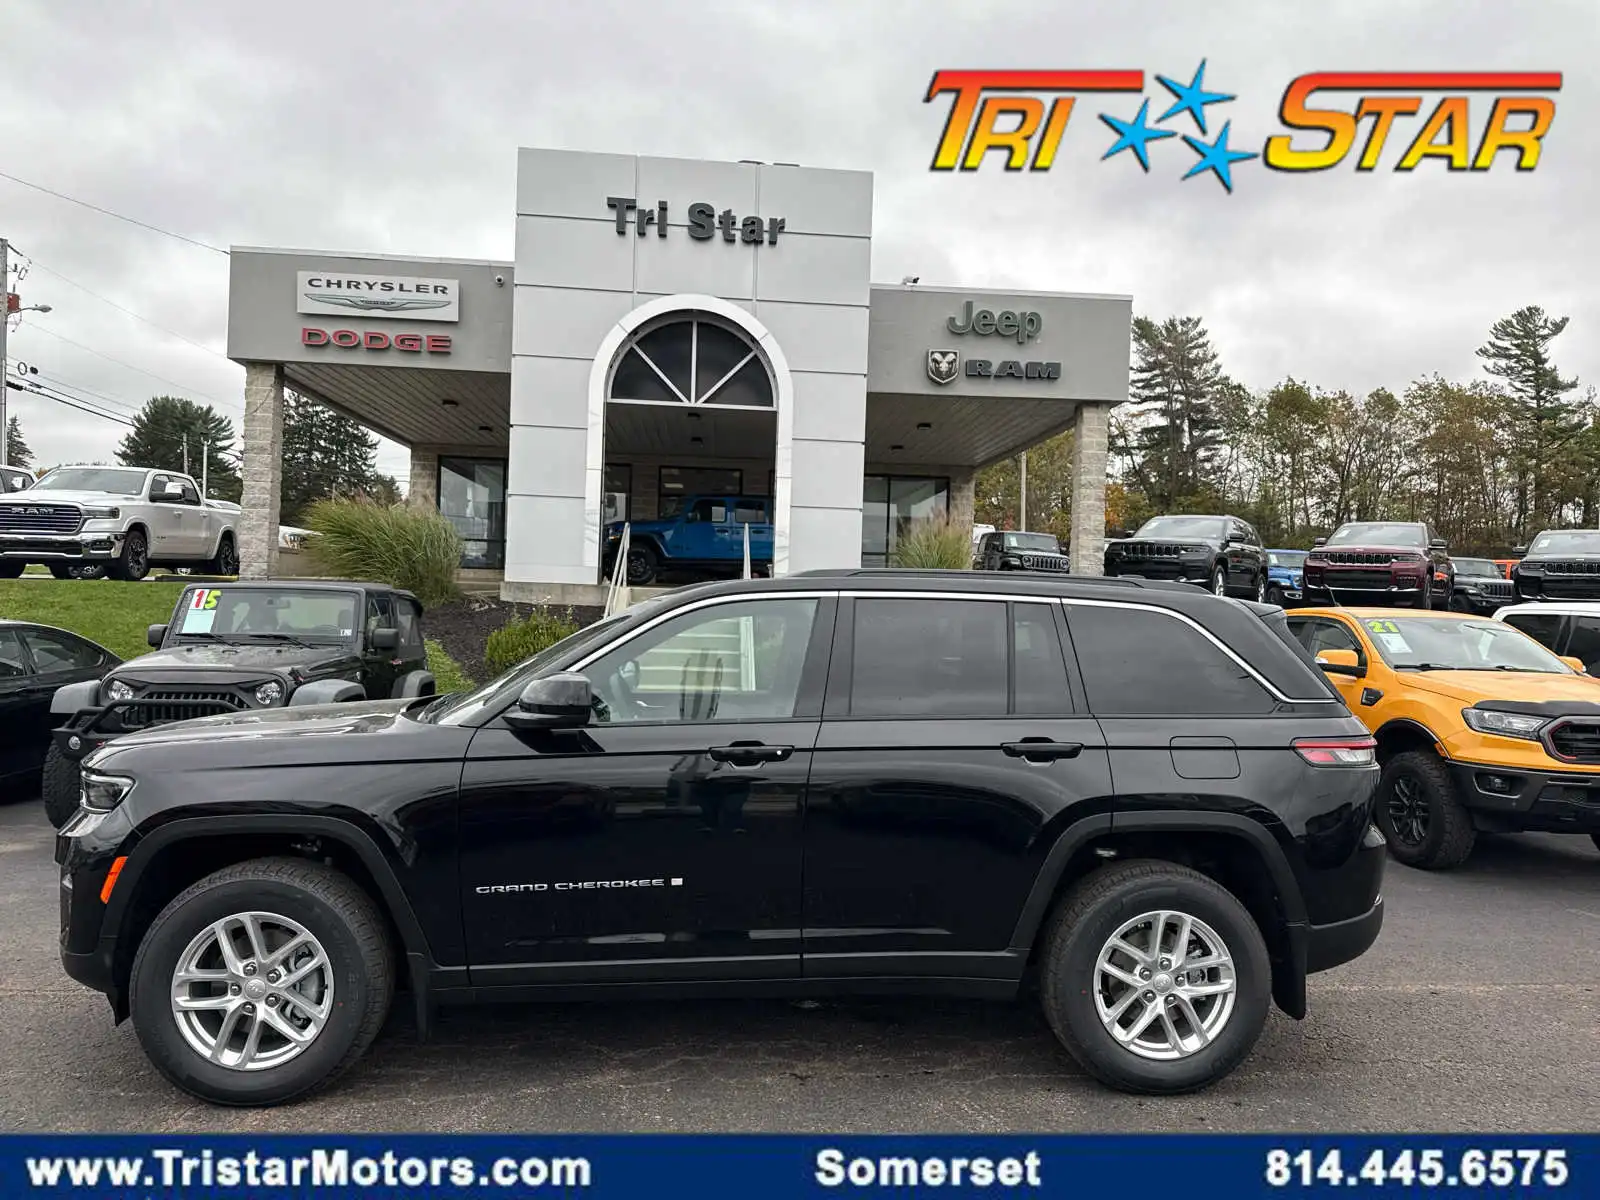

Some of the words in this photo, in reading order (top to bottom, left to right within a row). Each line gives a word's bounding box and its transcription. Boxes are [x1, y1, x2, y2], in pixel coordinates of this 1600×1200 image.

[607, 197, 668, 238] Tri
[688, 202, 786, 245] Star
[307, 278, 449, 295] CHRYSLER
[947, 301, 1042, 344] Jeep
[302, 327, 452, 354] DODGE
[966, 359, 1061, 379] RAM
[194, 589, 222, 610] 15
[1367, 620, 1401, 633] 21
[475, 883, 548, 894] GRAND
[554, 878, 665, 890] CHEROKEE
